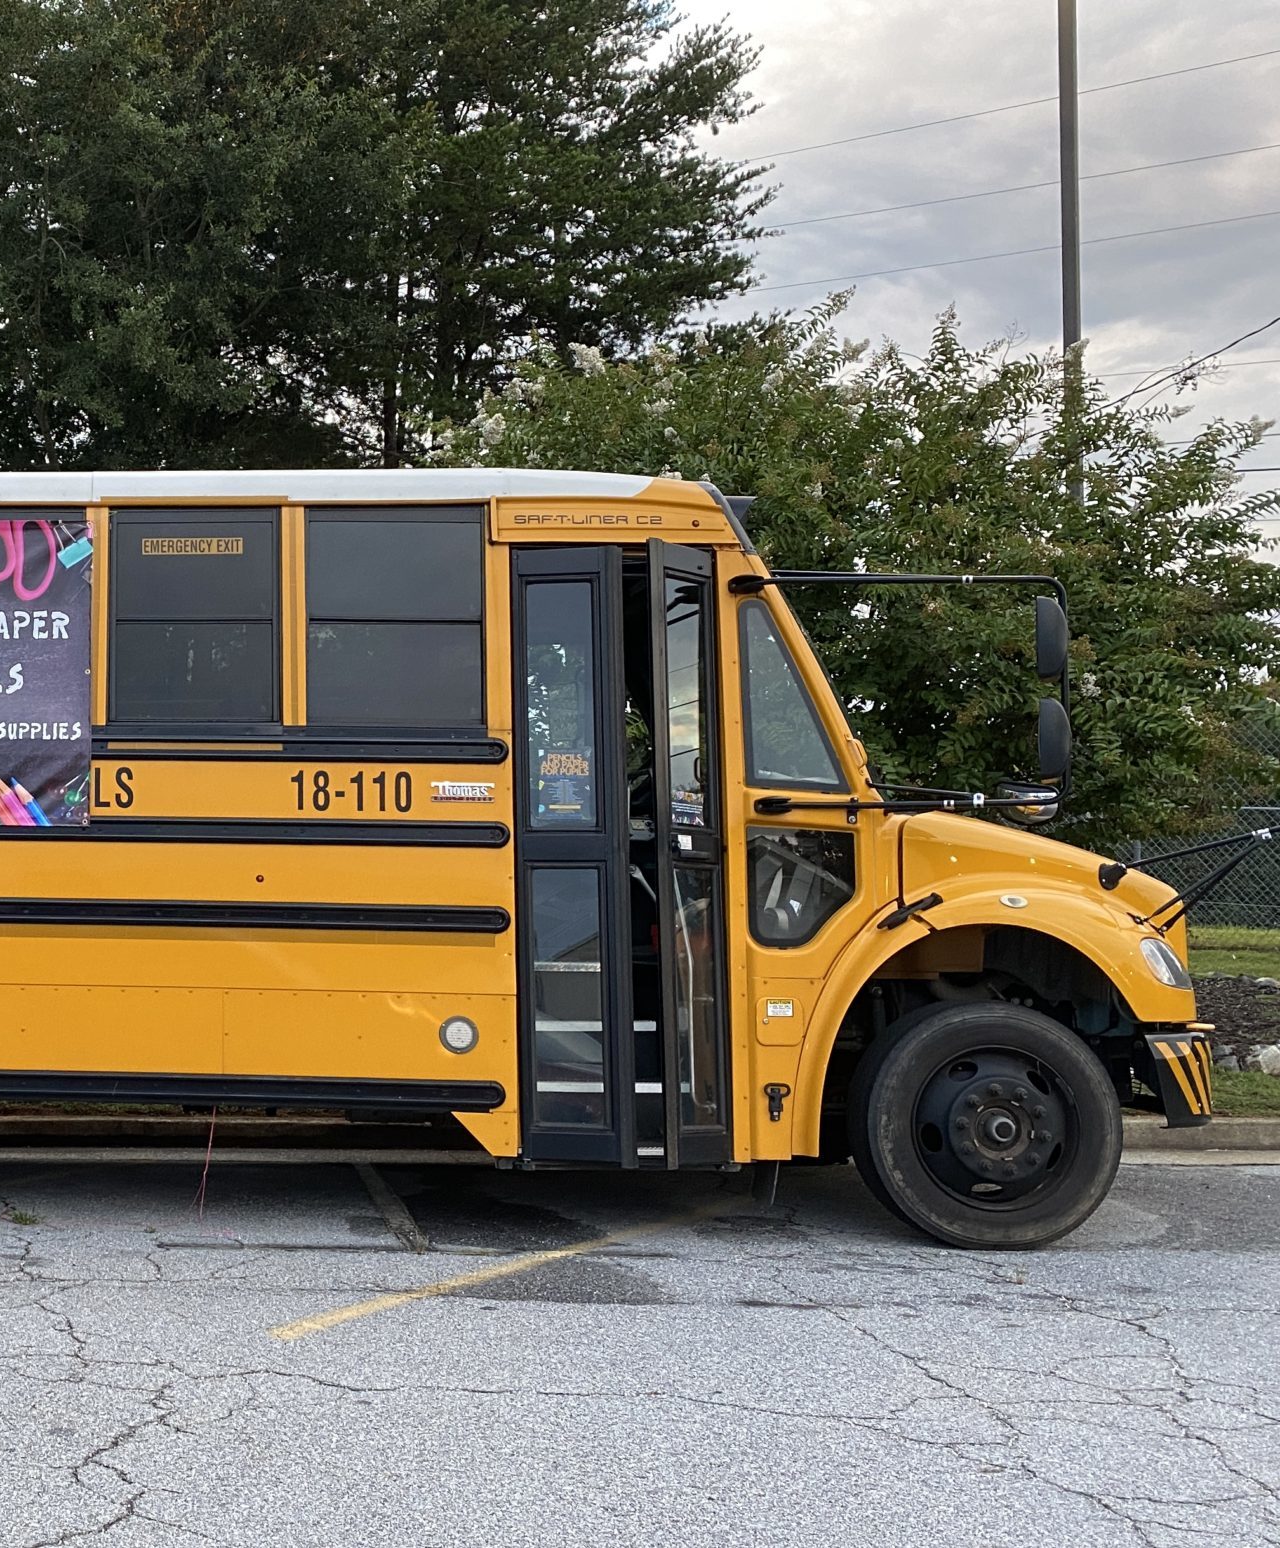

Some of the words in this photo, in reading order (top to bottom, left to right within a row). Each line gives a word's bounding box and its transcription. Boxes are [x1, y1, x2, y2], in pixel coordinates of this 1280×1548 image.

[514, 514, 629, 525] SAF-T-LINER
[636, 515, 662, 525] C2
[143, 539, 213, 554] EMERGENCY
[216, 538, 241, 553] EXIT
[547, 753, 582, 761] PENCILS
[561, 761, 589, 769] PAPER
[540, 768, 559, 776] FOR
[560, 768, 589, 776] PUPILS
[290, 770, 413, 813] 18-110
[431, 781, 495, 797] Thomas
